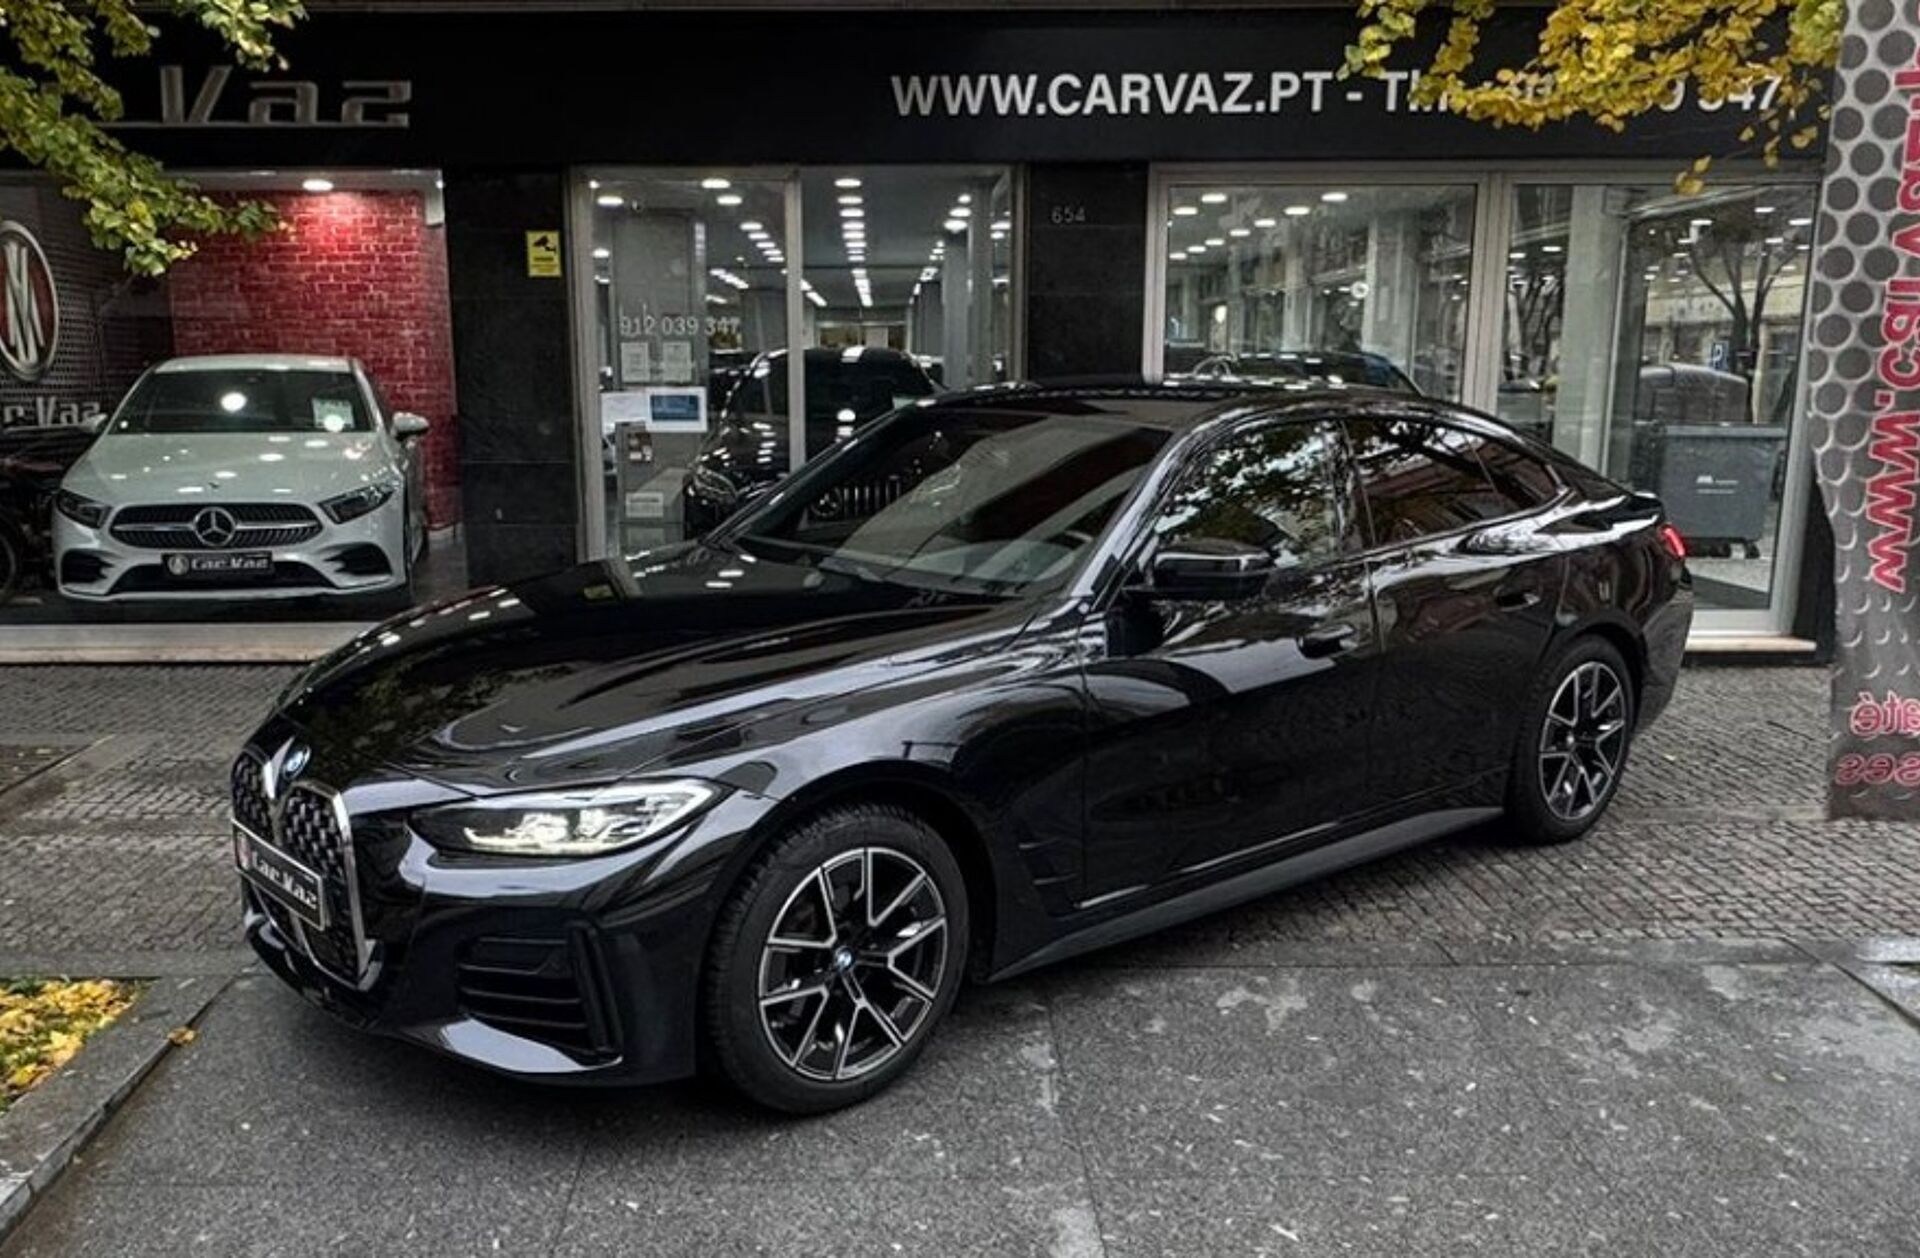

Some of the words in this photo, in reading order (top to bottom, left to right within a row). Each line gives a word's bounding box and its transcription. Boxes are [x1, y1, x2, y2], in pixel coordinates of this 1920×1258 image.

[159, 65, 412, 128] Vaz
[891, 71, 1334, 116] WWW.CARVAZ.PT
[1051, 205, 1086, 224] 654
[620, 314, 656, 337] 912
[662, 316, 698, 336] 039
[282, 870, 318, 911] Vaz
